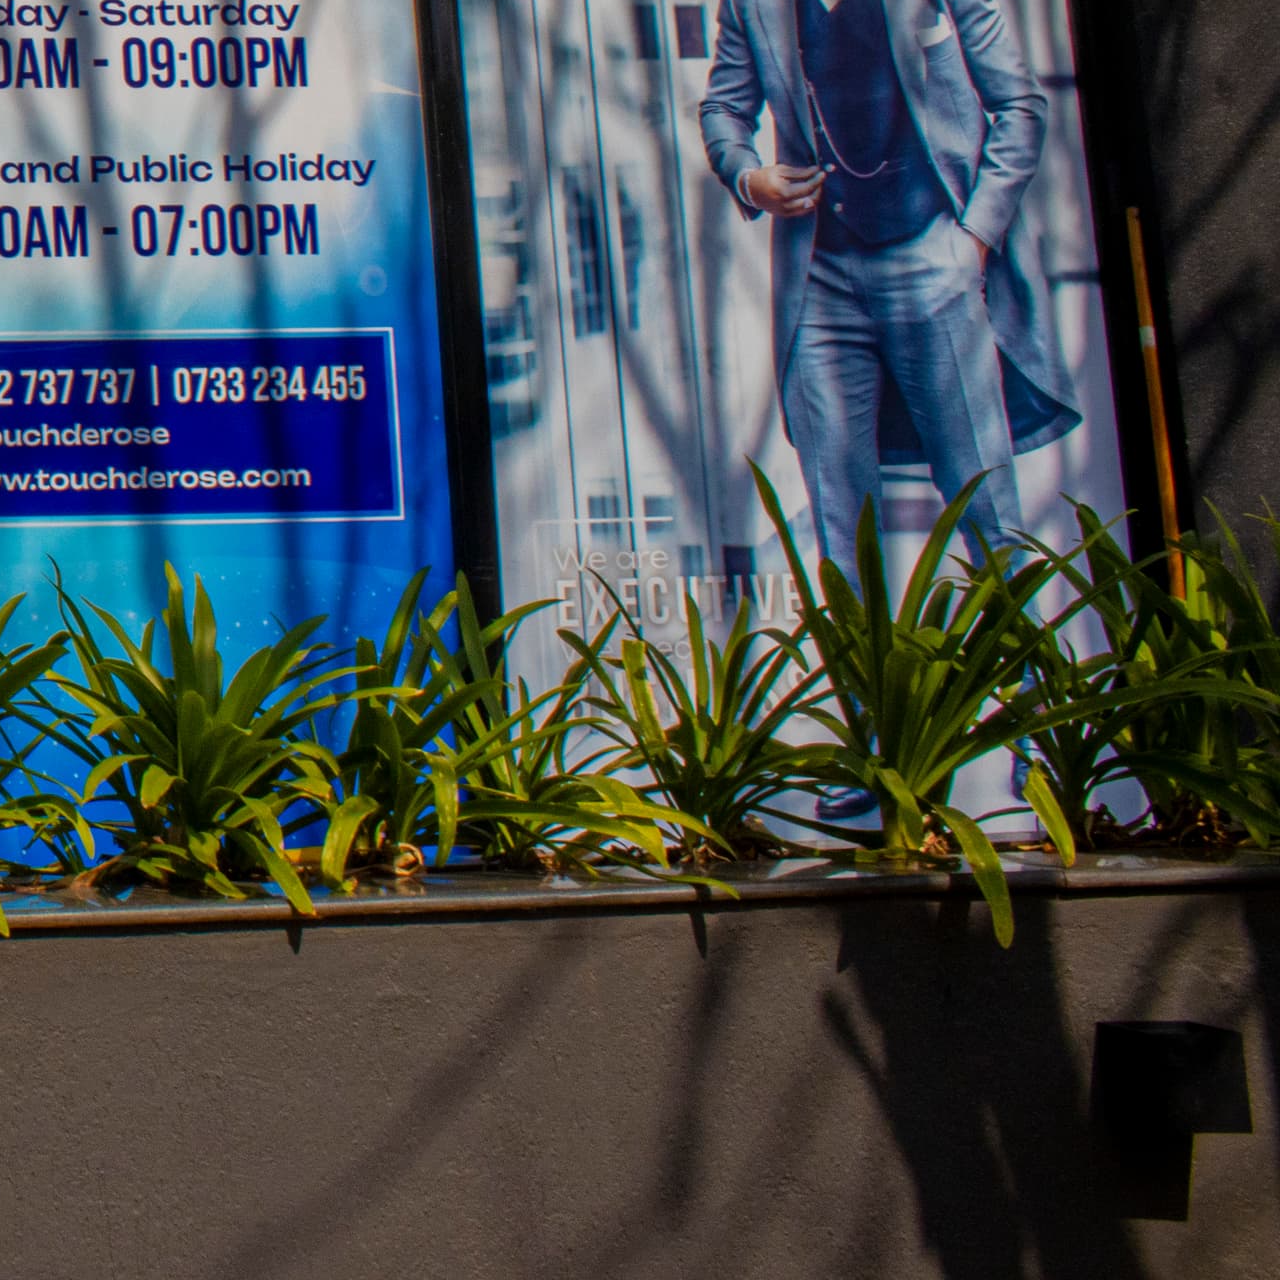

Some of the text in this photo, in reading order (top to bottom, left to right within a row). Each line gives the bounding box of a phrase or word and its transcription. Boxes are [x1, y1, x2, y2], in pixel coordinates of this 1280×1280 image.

[122, 36, 309, 89] 09:00PM
[0, 155, 80, 185] and
[90, 154, 213, 185] Public
[223, 153, 376, 187] Holiday
[131, 204, 320, 258] 07:00PM
[20, 369, 75, 405] 737
[82, 368, 136, 405] 737
[173, 366, 245, 404] 0733
[252, 365, 307, 403] 234
[312, 365, 366, 401] 455
[553, 548, 669, 571] We are
[555, 572, 804, 628] EXECUTIVE
